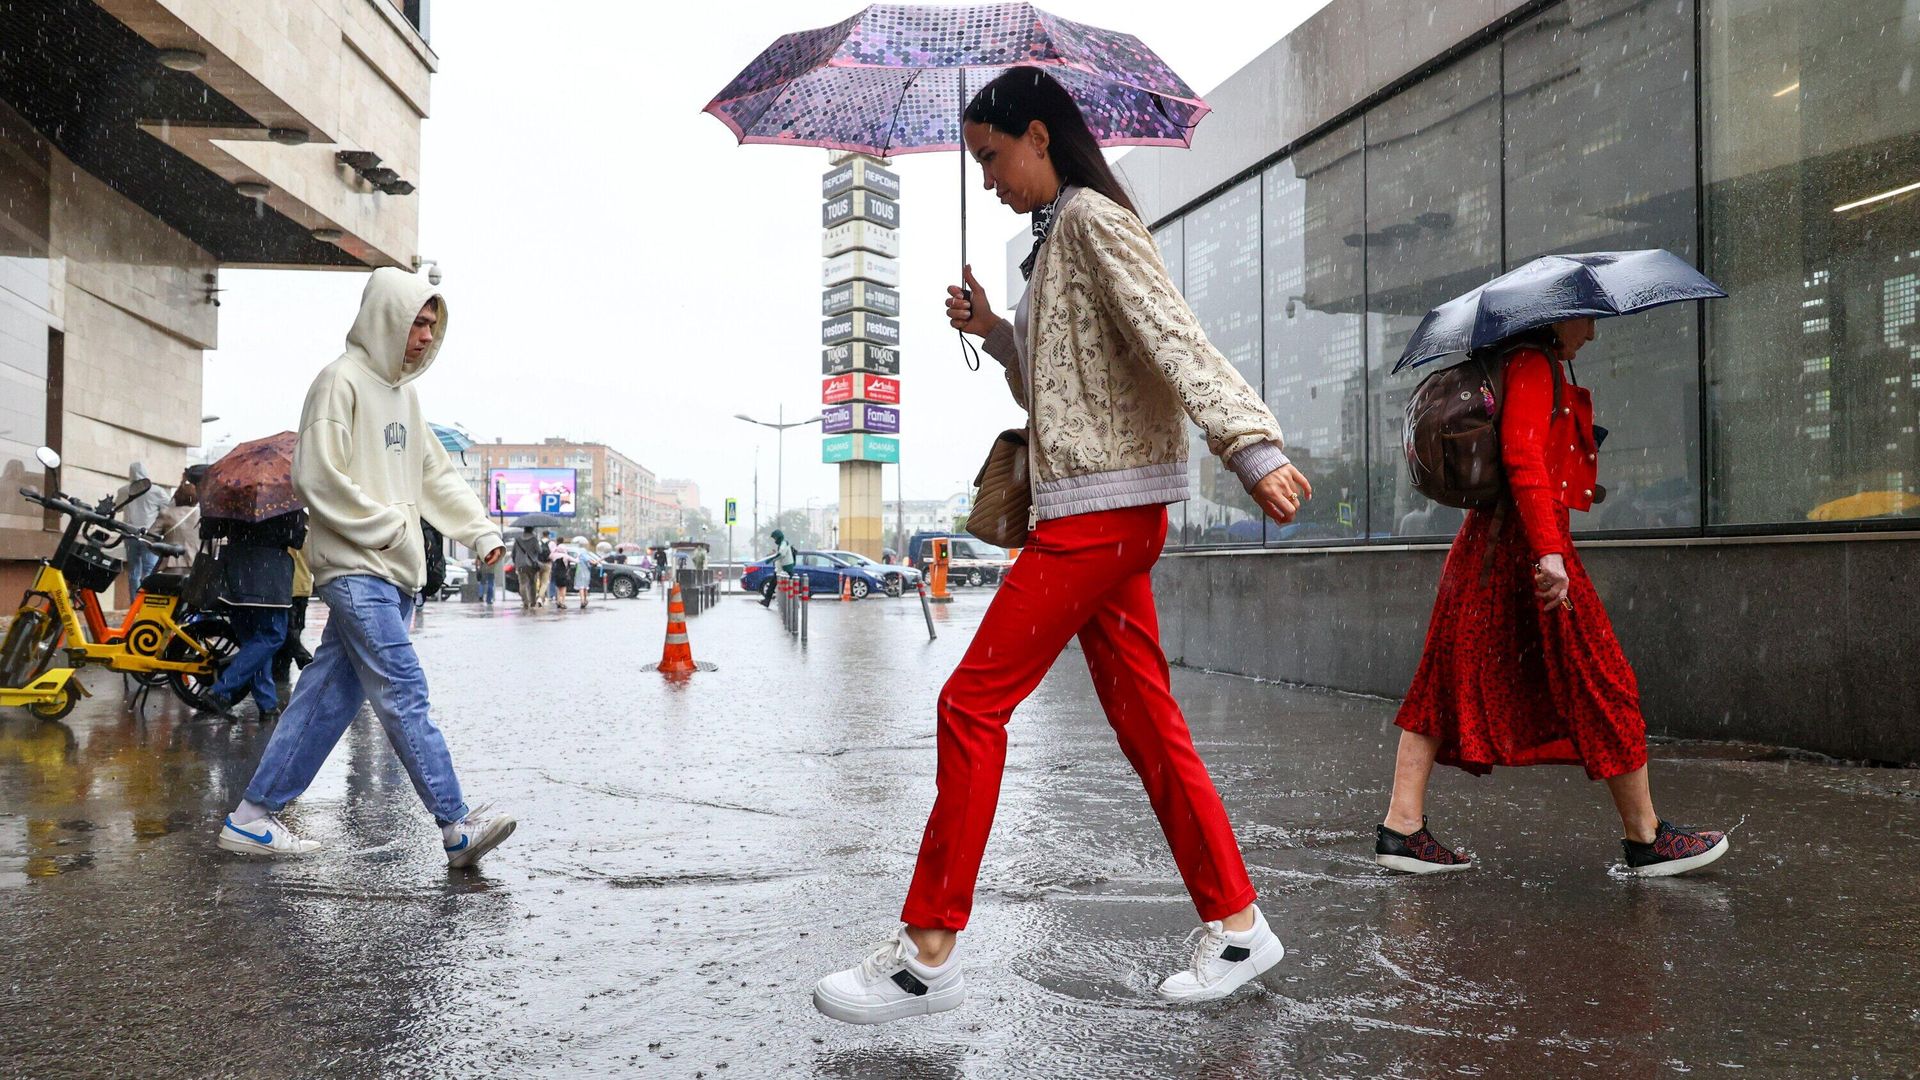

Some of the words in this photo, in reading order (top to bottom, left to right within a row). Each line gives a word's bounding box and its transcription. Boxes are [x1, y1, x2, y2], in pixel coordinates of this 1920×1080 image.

[827, 199, 849, 220] TOUS
[870, 199, 894, 220] TOUS
[867, 408, 896, 424] familia
[545, 495, 558, 512] P
